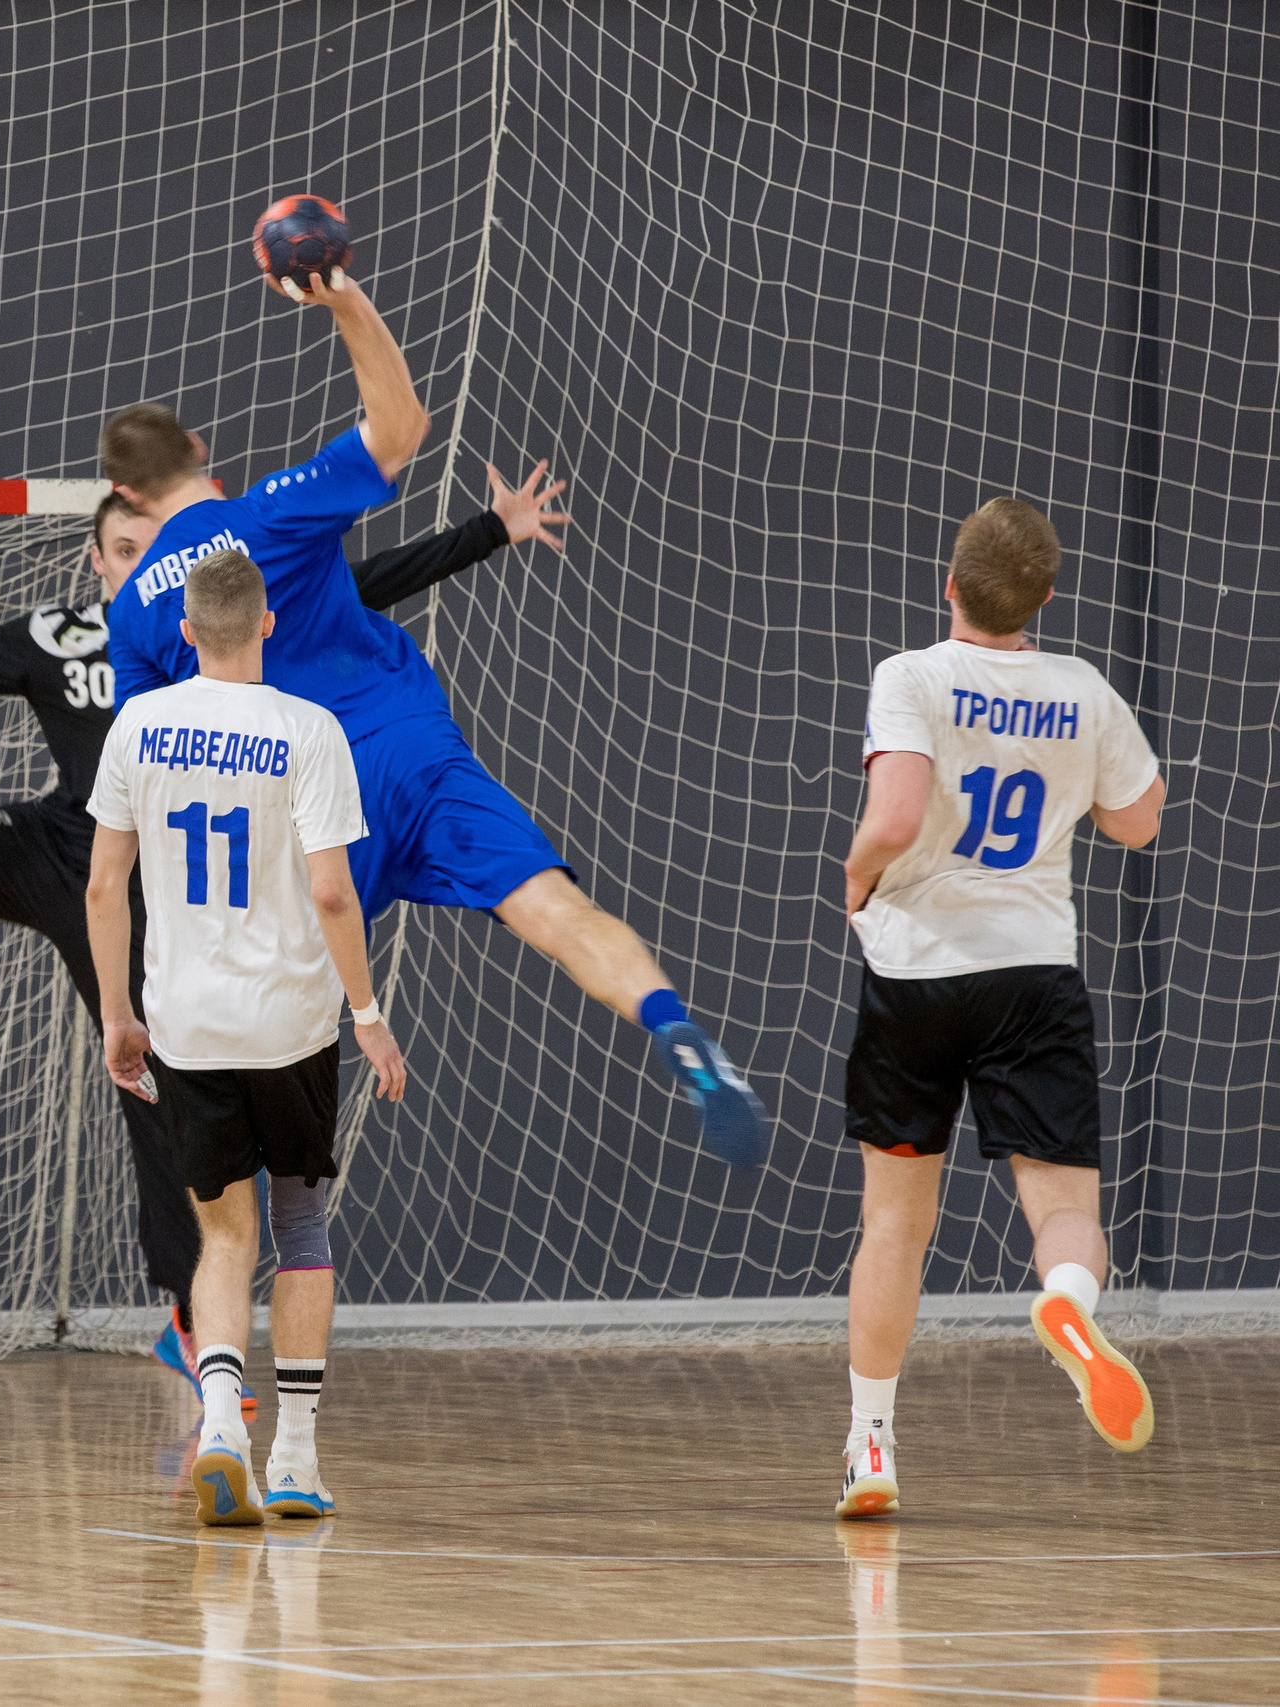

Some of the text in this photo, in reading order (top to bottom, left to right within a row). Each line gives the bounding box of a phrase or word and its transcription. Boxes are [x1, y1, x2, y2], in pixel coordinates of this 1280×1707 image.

[62, 659, 116, 709] 30
[951, 689, 1078, 739] ТРОПИН
[138, 727, 290, 778] МЕДВЕДКОВ
[952, 765, 1047, 870] 19
[166, 801, 250, 909] 11
